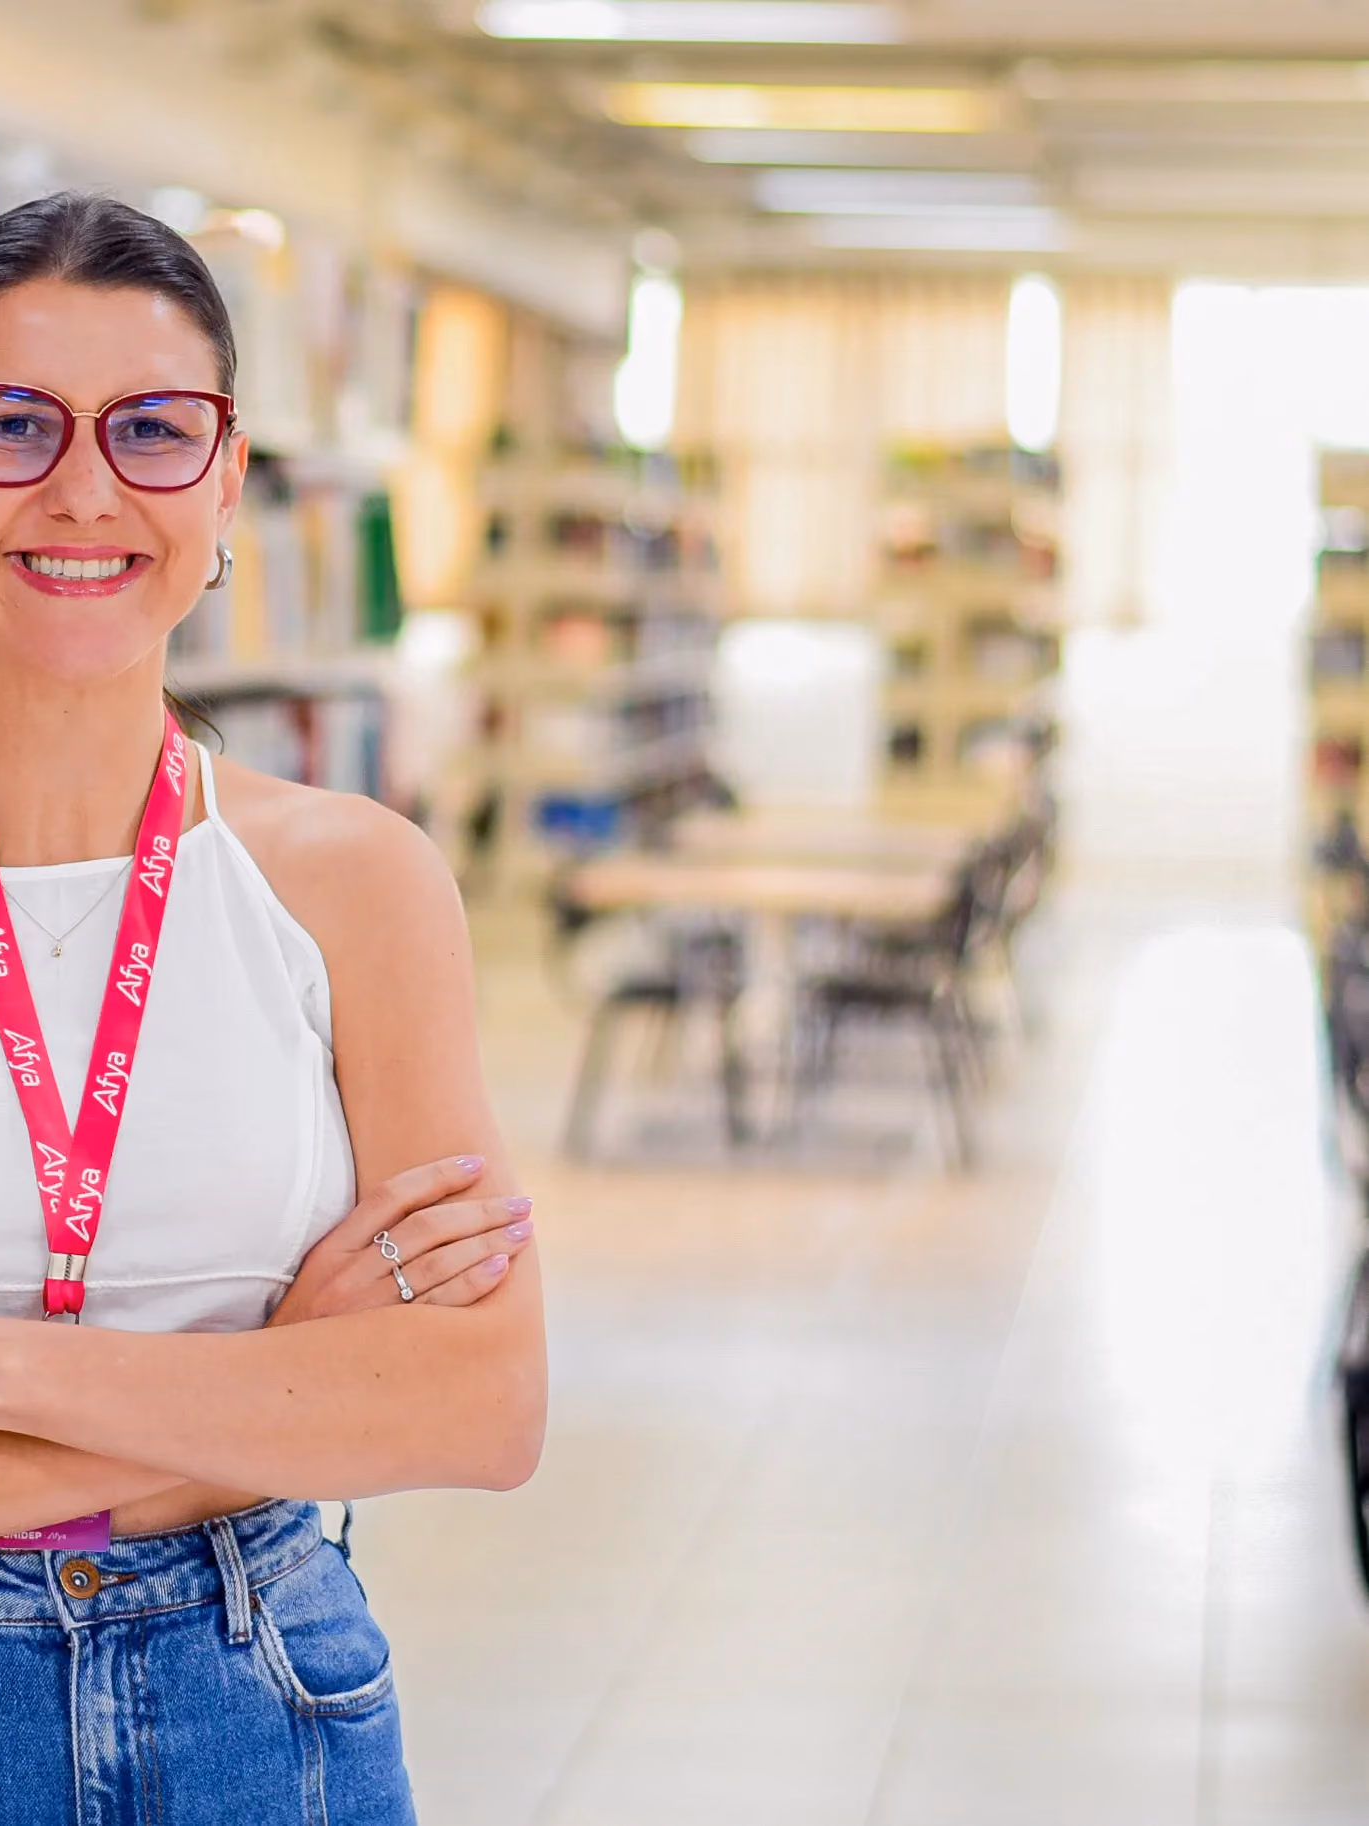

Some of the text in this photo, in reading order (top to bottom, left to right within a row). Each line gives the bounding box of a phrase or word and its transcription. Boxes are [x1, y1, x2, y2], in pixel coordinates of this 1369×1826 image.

[165, 732, 187, 796] Afya
[138, 835, 172, 898] Afya
[115, 942, 152, 1008] Afya
[4, 1028, 41, 1087] Afya
[92, 1051, 129, 1117] Afya
[66, 1168, 103, 1242] Afya
